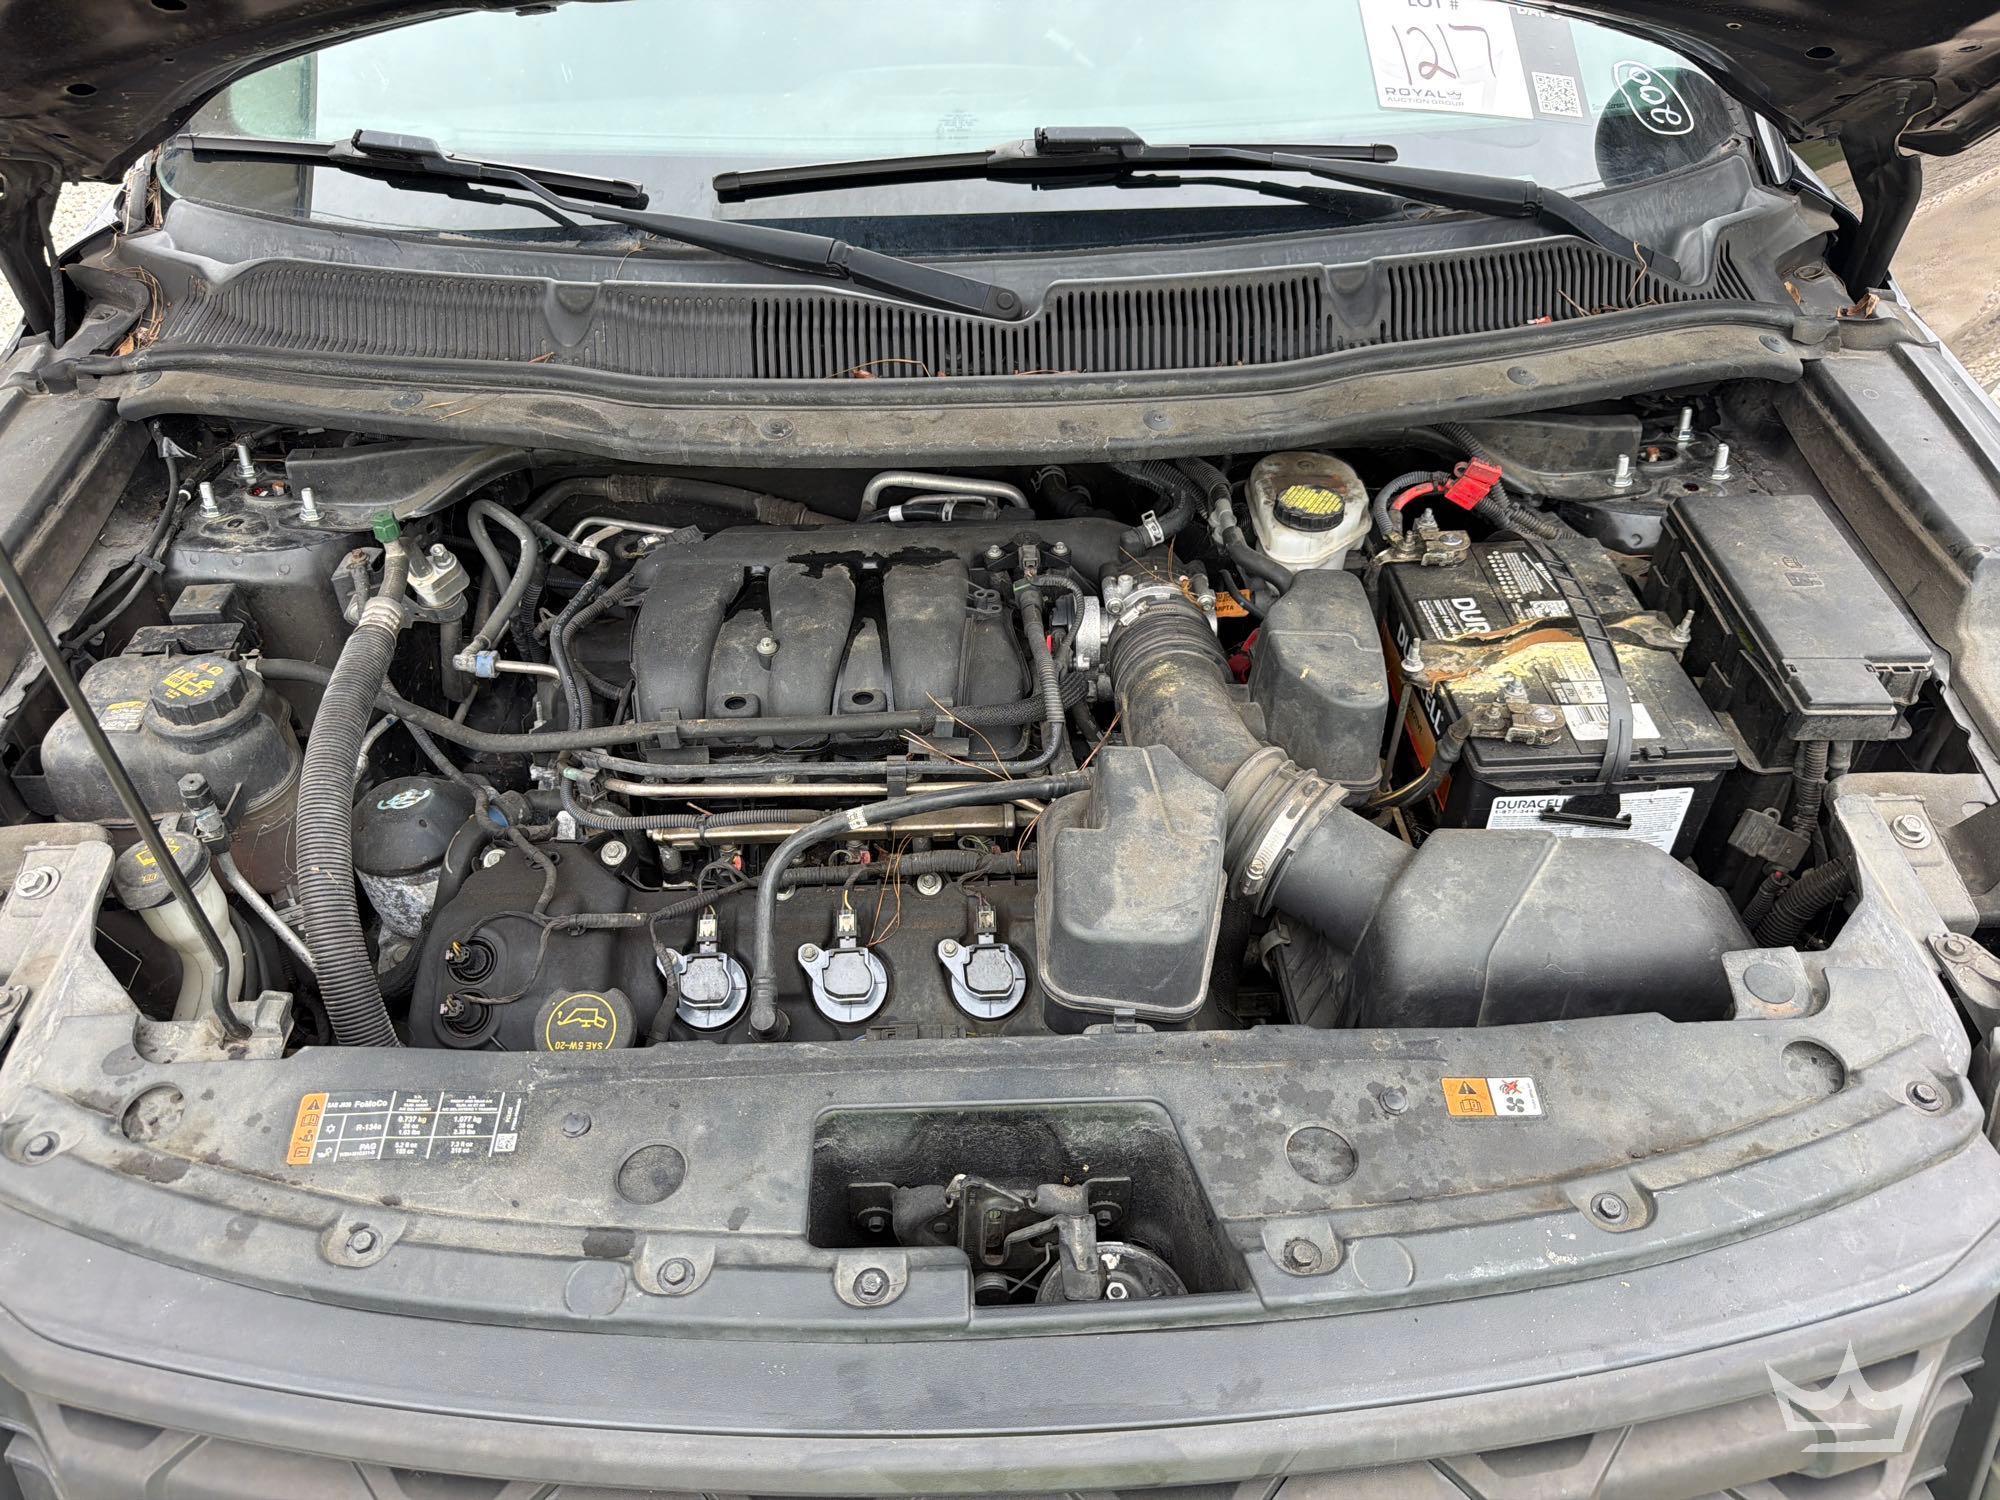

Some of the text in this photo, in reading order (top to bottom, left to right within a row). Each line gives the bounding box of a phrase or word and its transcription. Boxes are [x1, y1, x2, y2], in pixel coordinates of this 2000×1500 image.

[1392, 24, 1496, 86] 1217
[1385, 87, 1446, 99] ROYAL
[586, 1041, 603, 1050] SAE
[354, 1099, 388, 1108] FoMoCo
[356, 1123, 382, 1131] R-134a
[359, 1143, 377, 1151] PAG
